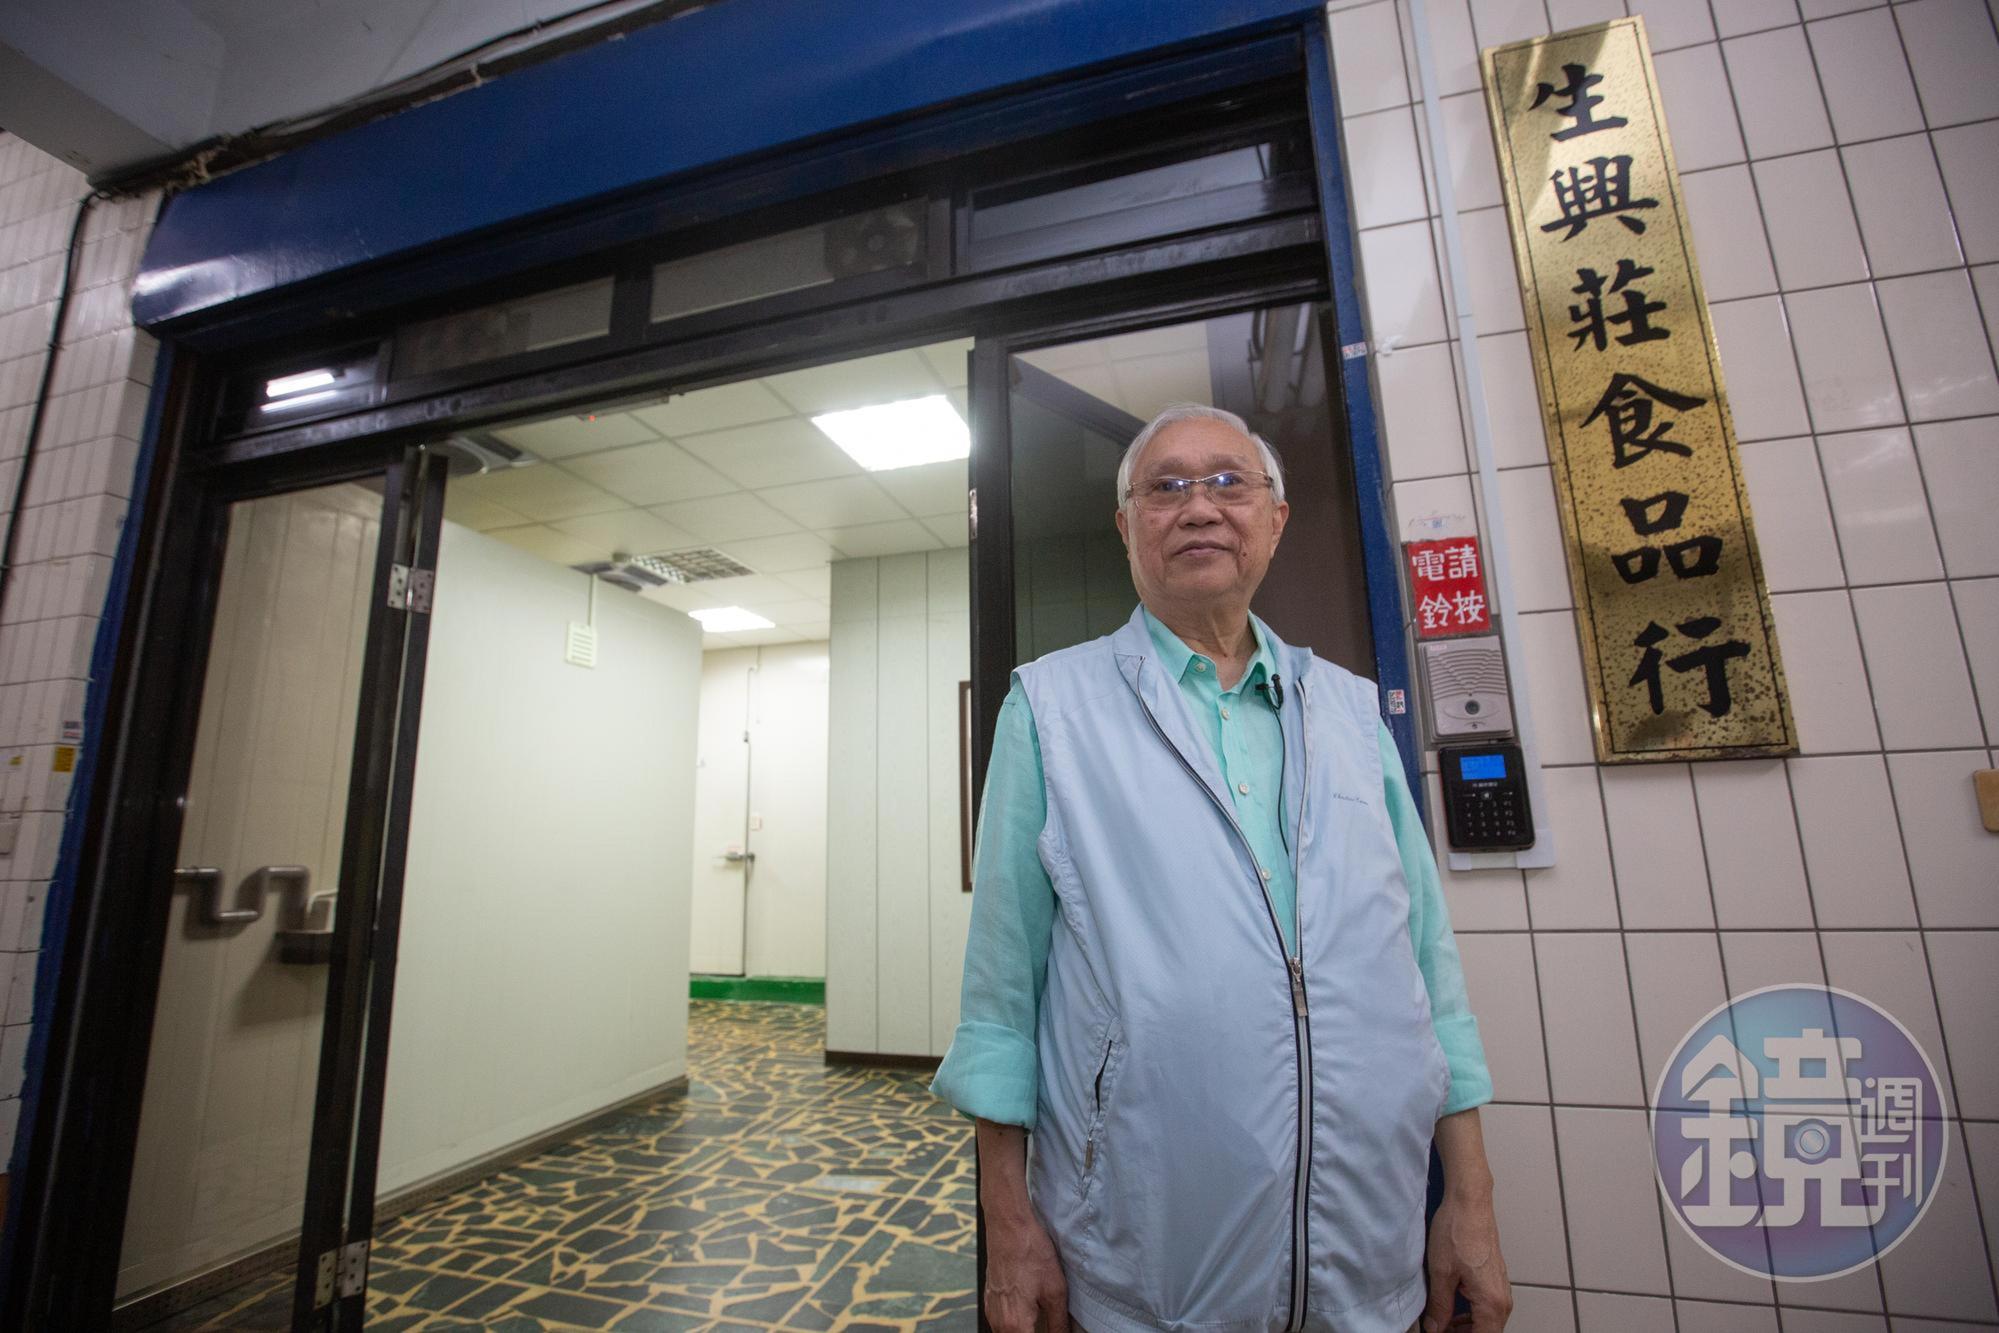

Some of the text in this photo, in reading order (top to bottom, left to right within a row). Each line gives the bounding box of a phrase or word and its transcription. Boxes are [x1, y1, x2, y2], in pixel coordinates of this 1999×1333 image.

[1528, 63, 1752, 718] 生興莊食品行
